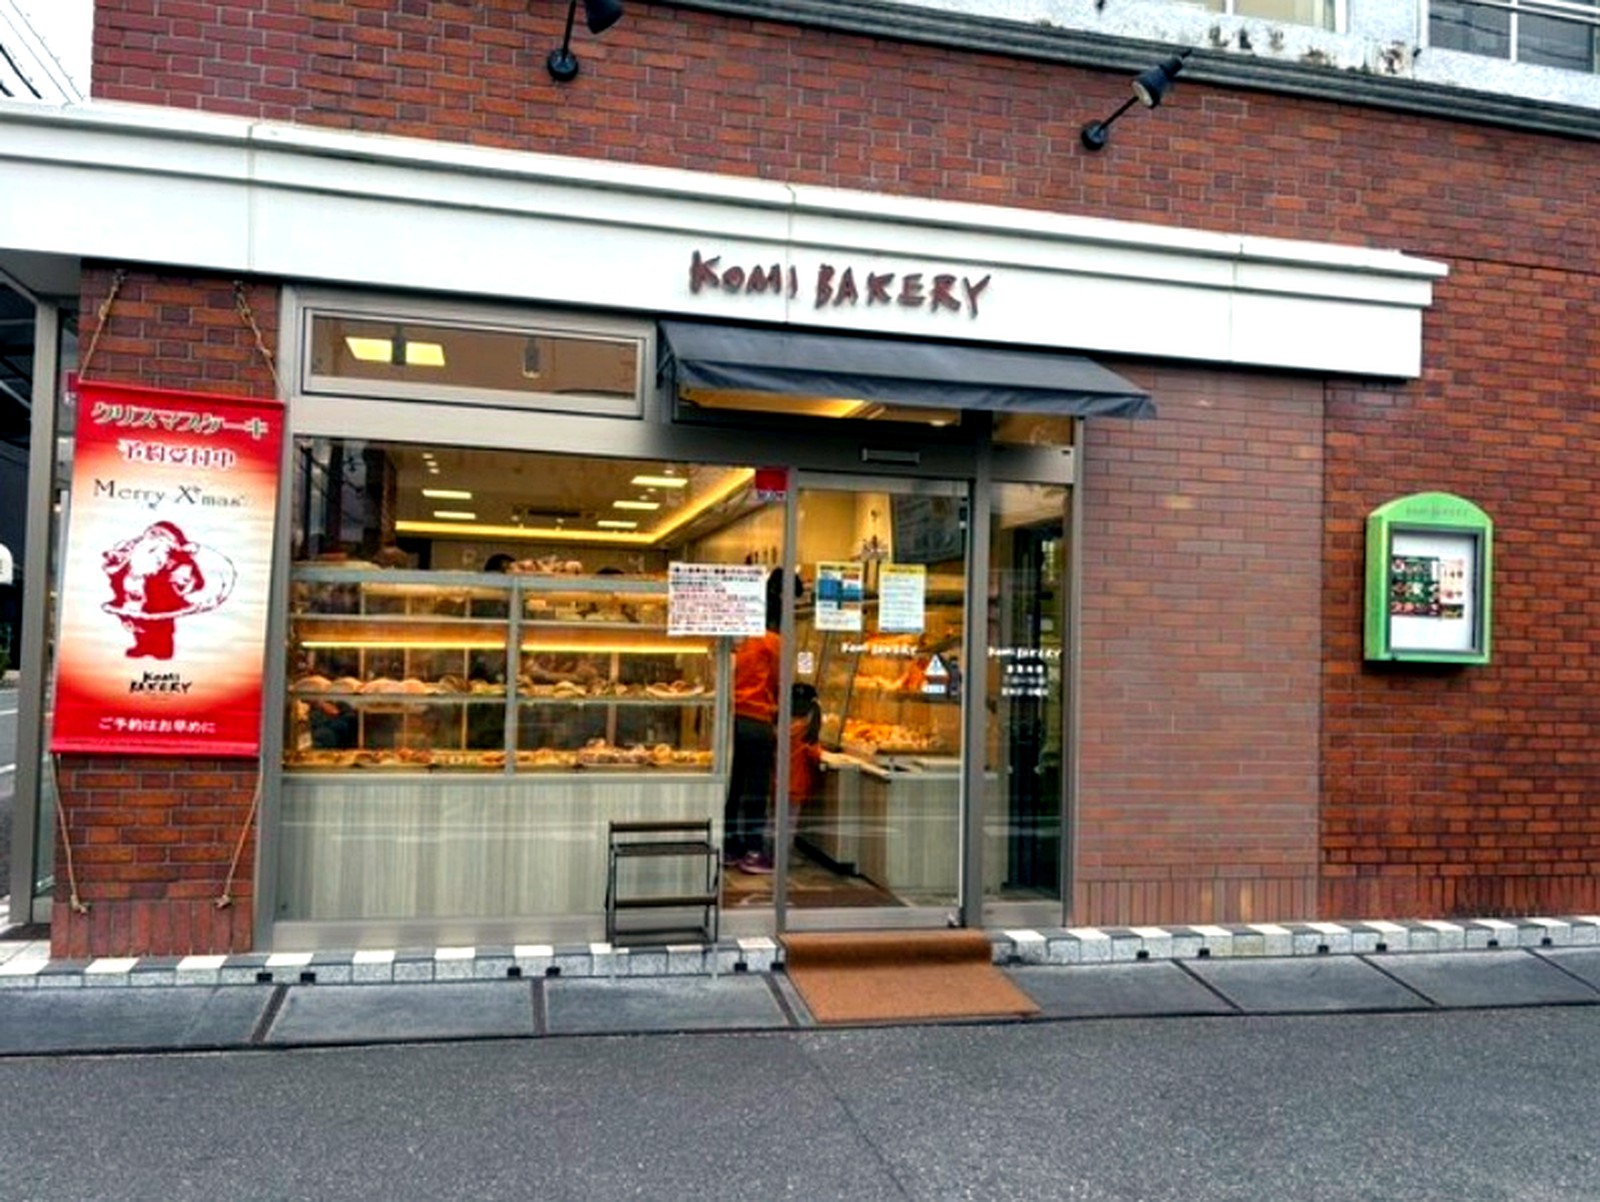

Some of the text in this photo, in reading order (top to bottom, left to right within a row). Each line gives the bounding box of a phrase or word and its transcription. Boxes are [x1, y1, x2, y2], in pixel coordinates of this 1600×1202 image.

[814, 263, 992, 319] BAKERY
[91, 401, 270, 440] クリスマスケーキ
[93, 477, 166, 511] Merry
[98, 716, 217, 734] ご予約はお早めに
